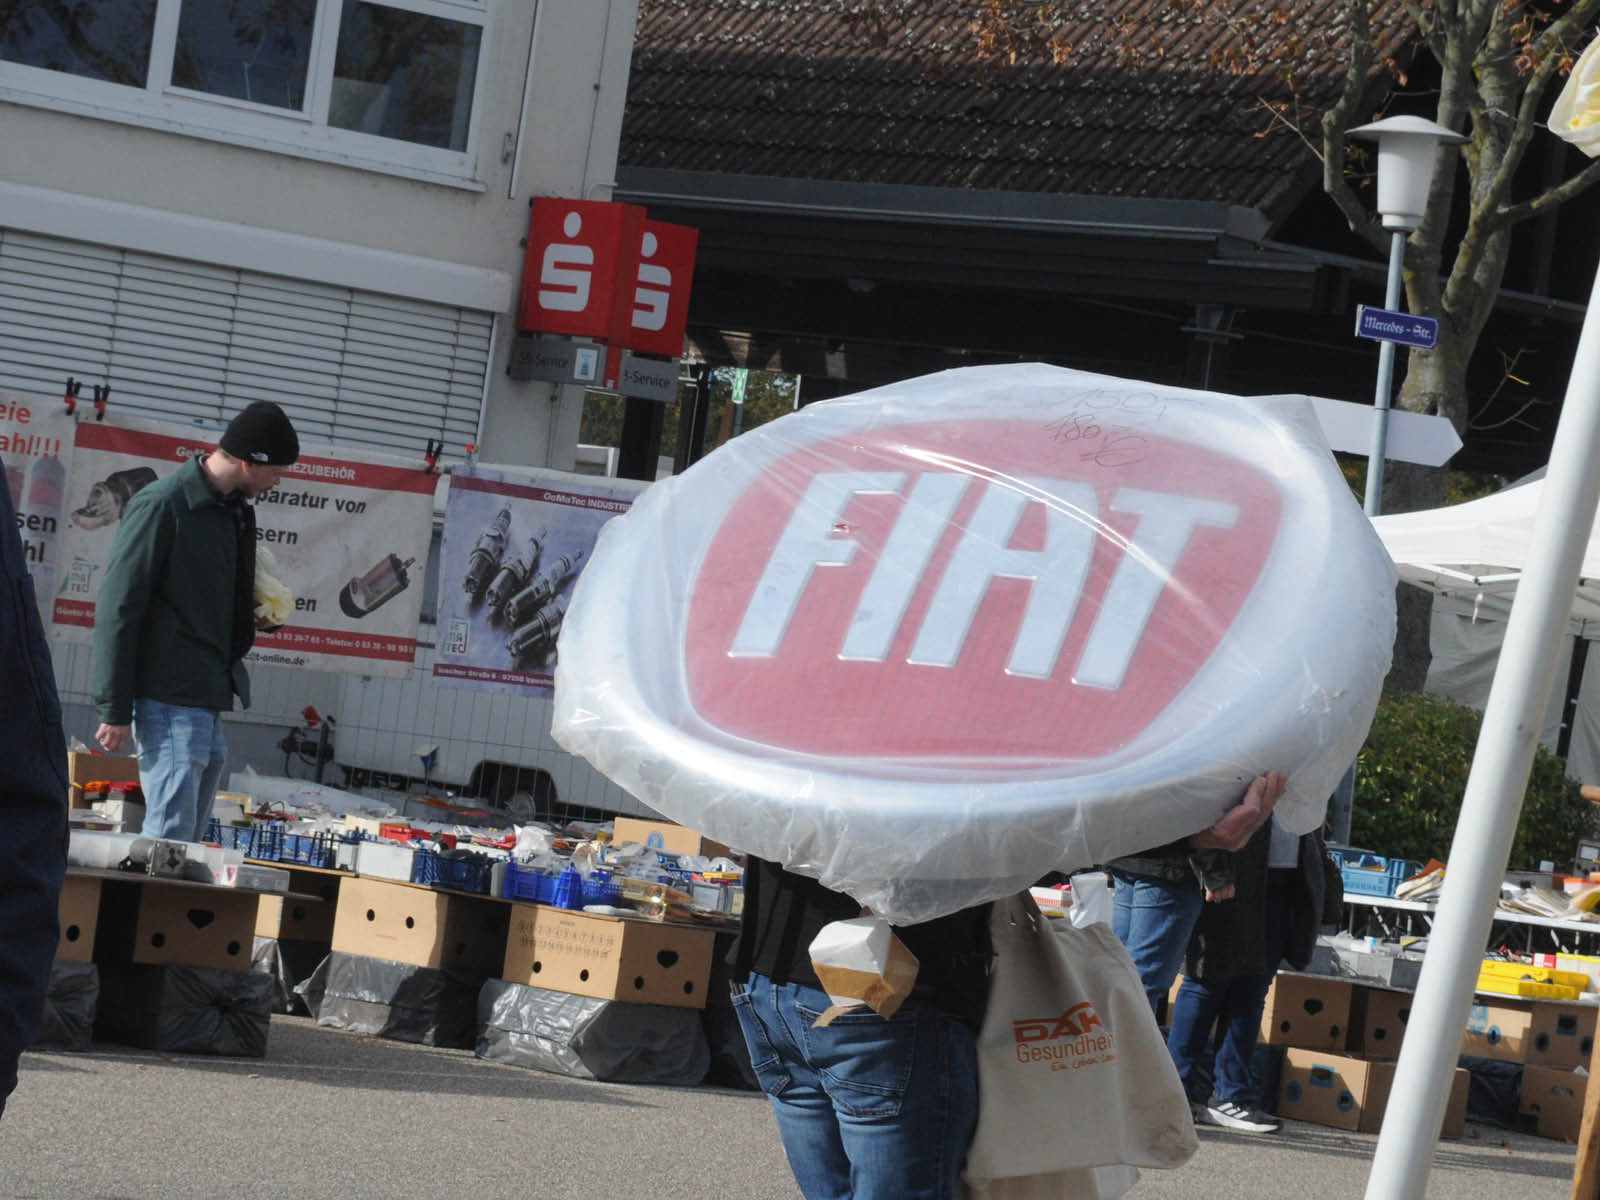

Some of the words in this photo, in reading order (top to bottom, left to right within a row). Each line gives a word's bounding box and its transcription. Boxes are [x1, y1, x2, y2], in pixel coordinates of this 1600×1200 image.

[255, 489, 329, 510] paratur
[335, 498, 367, 514] von
[727, 470, 1241, 690] FIAT
[1013, 1001, 1103, 1042] DAK
